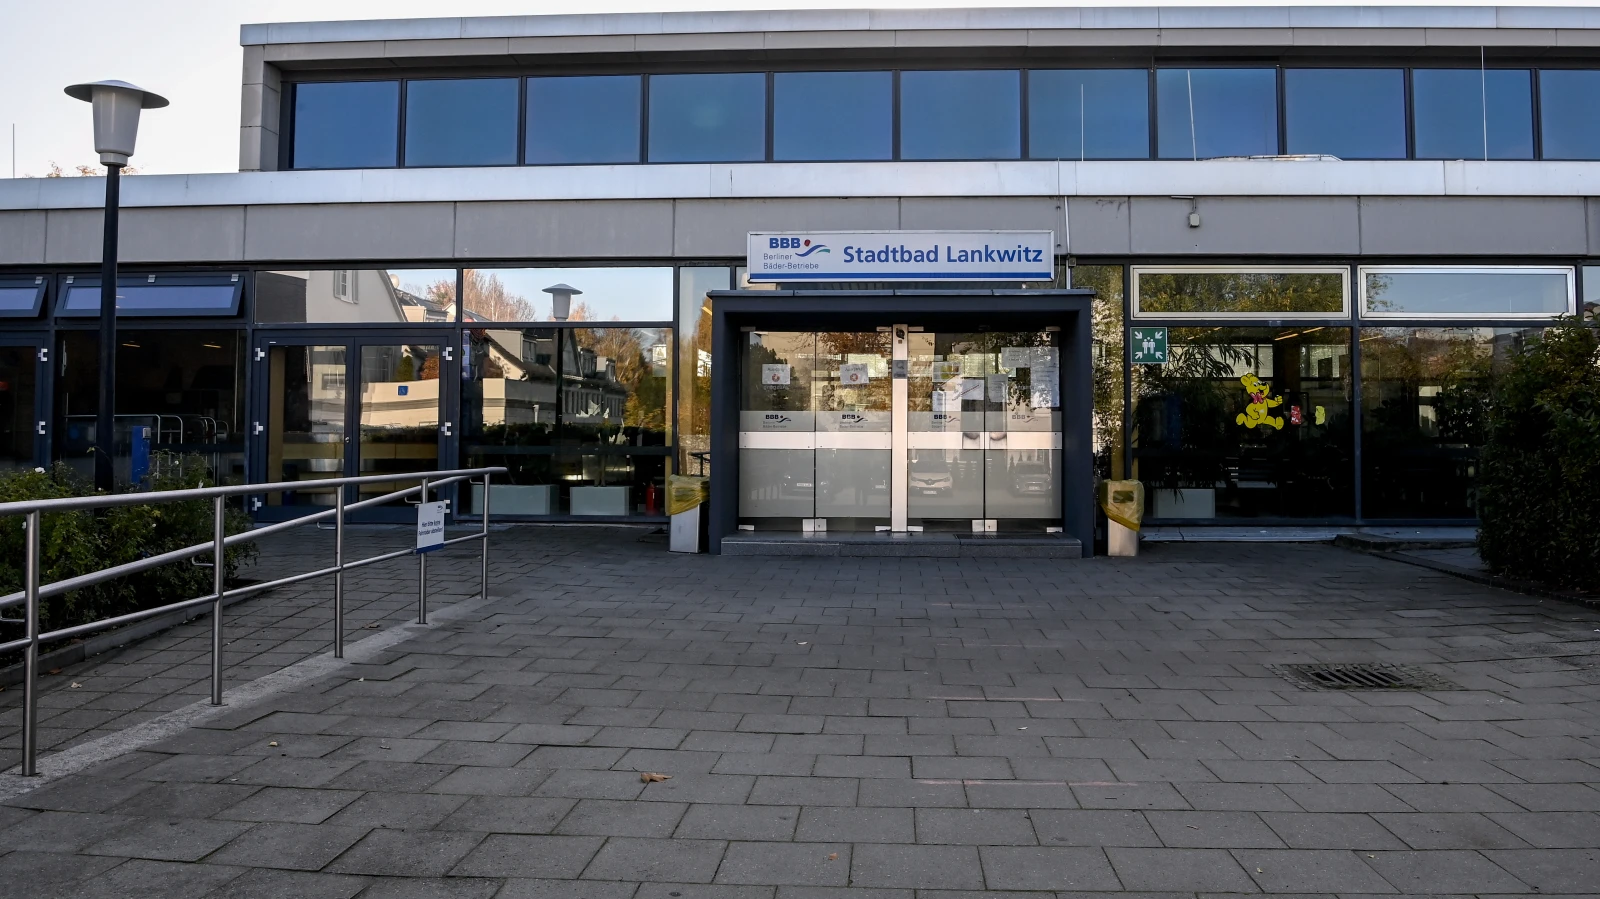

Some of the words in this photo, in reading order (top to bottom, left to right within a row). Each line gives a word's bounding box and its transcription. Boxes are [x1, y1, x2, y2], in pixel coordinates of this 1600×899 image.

[769, 238, 801, 249] BBB
[843, 244, 939, 263] Stadtbad
[946, 244, 1043, 263] Lankwitz
[763, 262, 819, 270] Bäder-Betriebe
